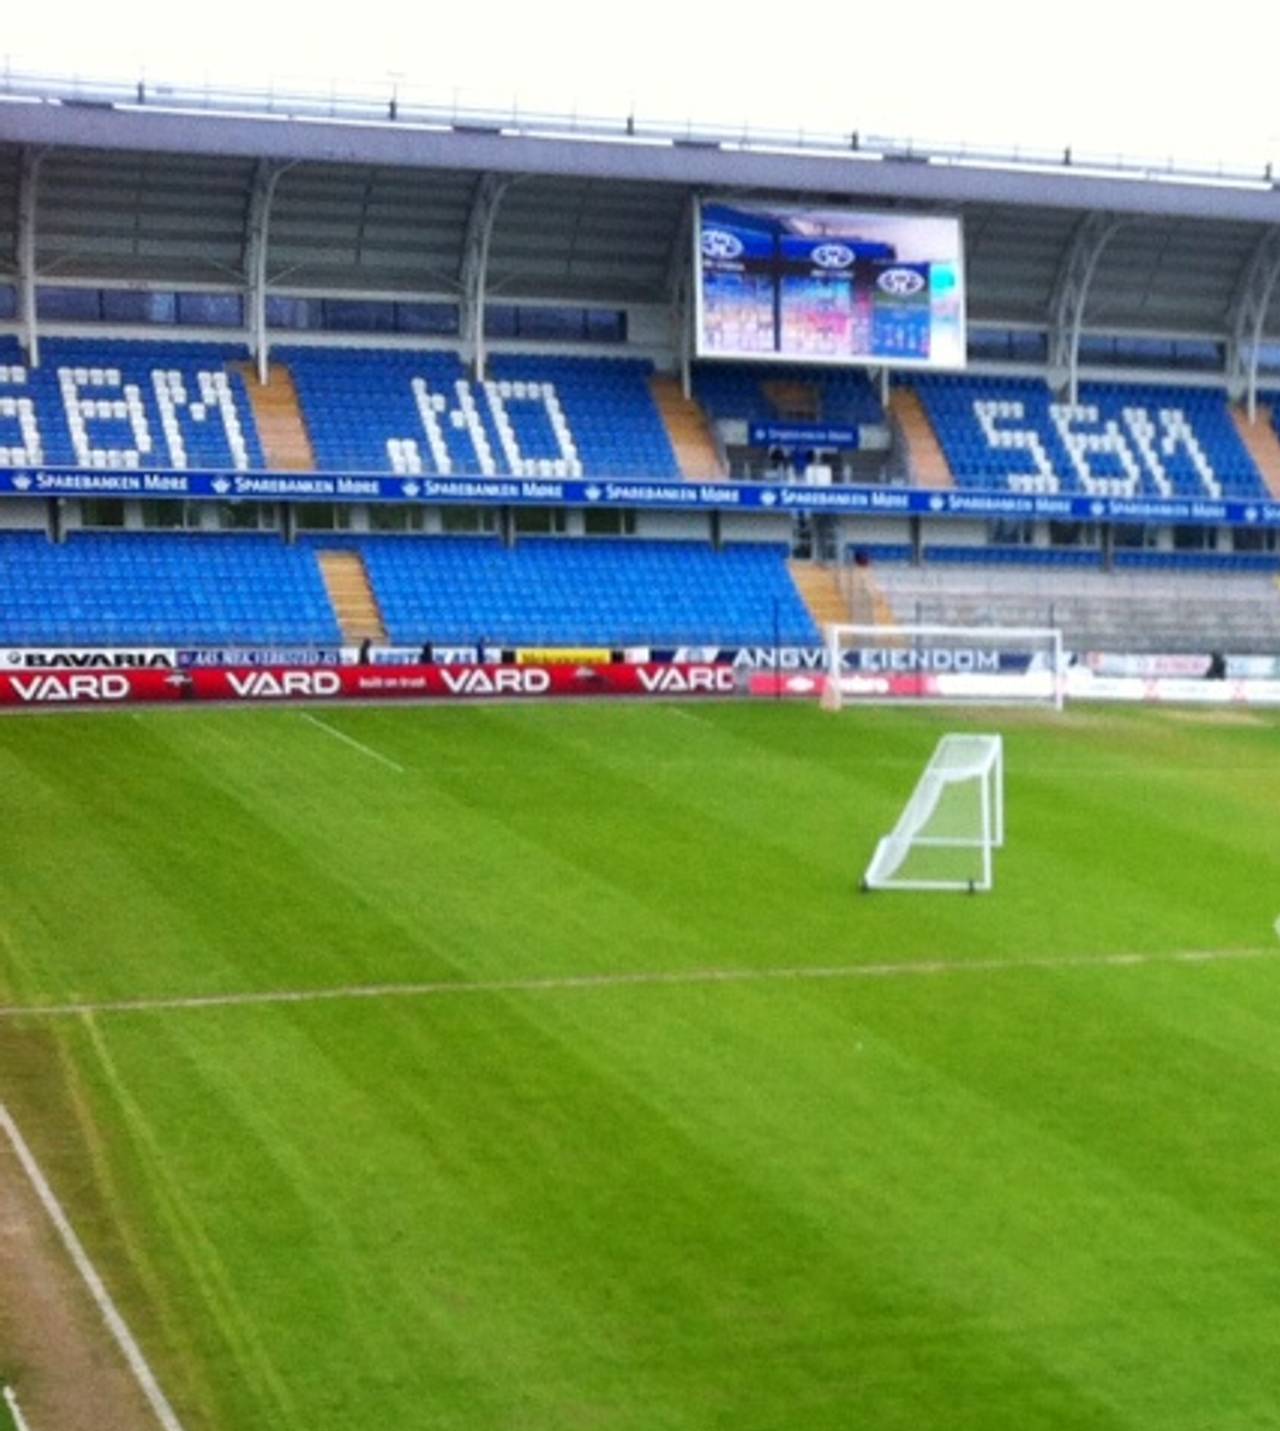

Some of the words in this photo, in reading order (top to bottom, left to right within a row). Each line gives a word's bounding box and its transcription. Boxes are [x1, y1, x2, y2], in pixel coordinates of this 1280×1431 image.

[25, 653, 174, 667] BAVARIA
[733, 648, 849, 668] ANGVIK
[860, 649, 999, 670] EIENDOM
[9, 675, 130, 699] VARD
[226, 671, 340, 695] VARD
[440, 669, 549, 692] VARD
